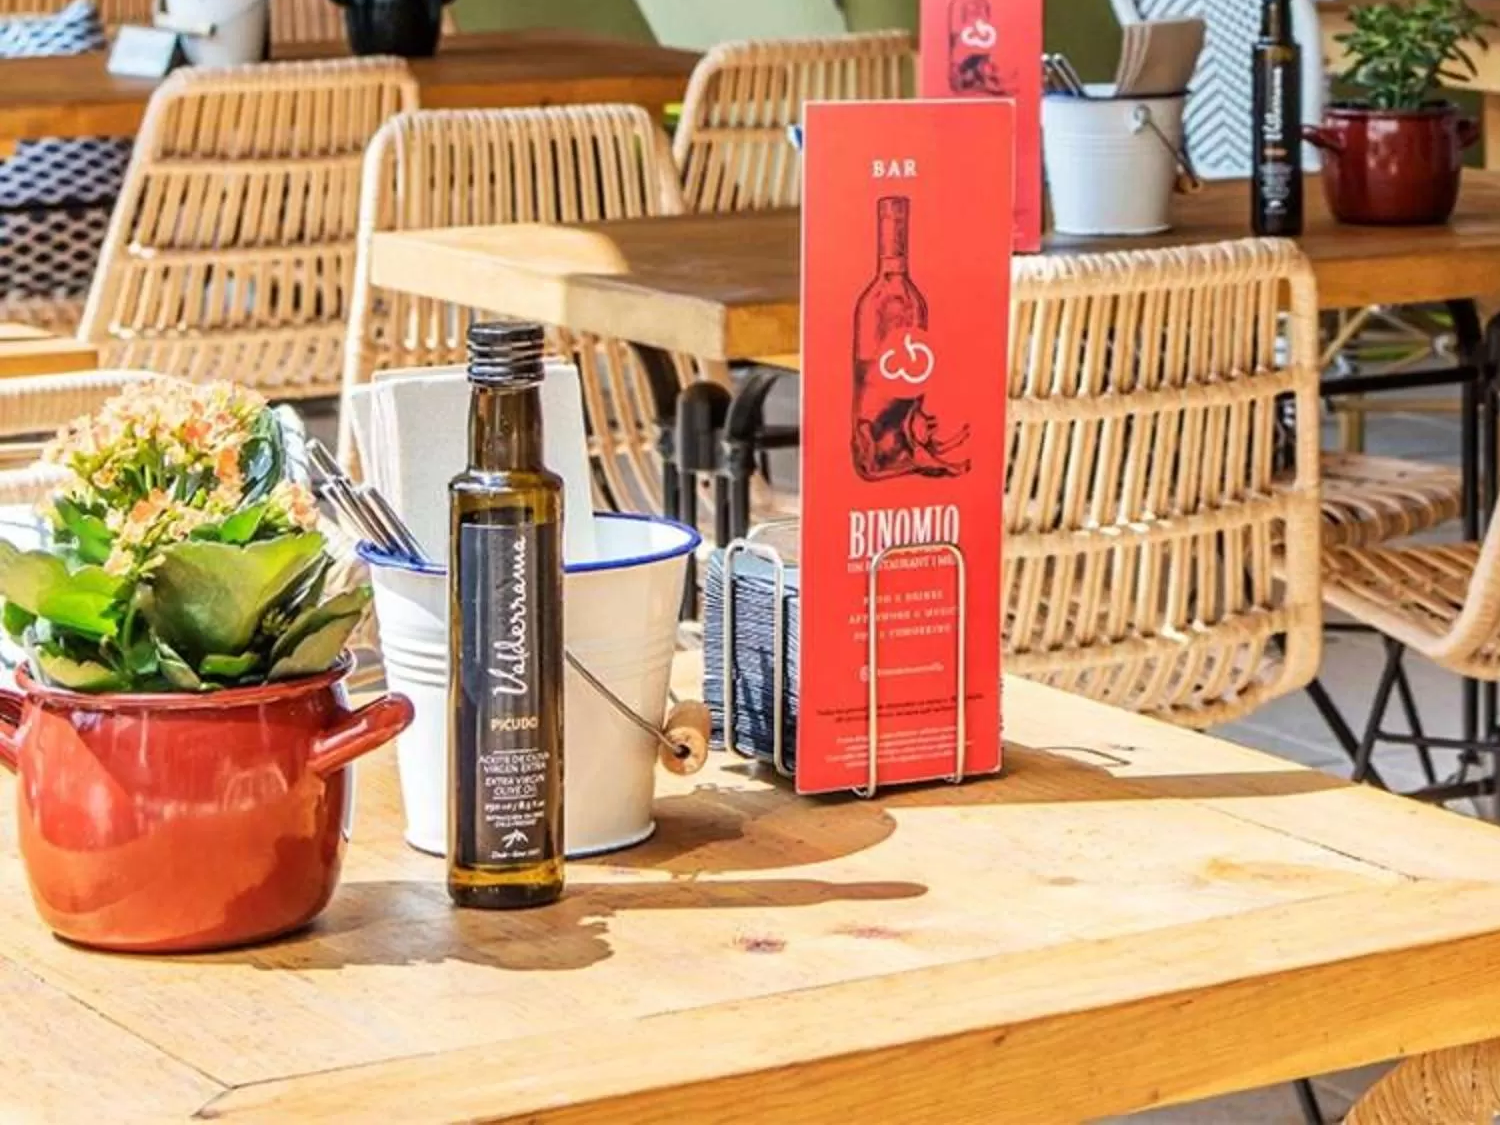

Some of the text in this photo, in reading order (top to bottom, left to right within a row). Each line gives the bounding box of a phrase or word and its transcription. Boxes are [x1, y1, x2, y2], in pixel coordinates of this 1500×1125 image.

[870, 159, 918, 179] BAR
[847, 503, 960, 560] BINOMIO
[487, 534, 530, 697] Valderrama
[490, 716, 539, 732] PICUDO
